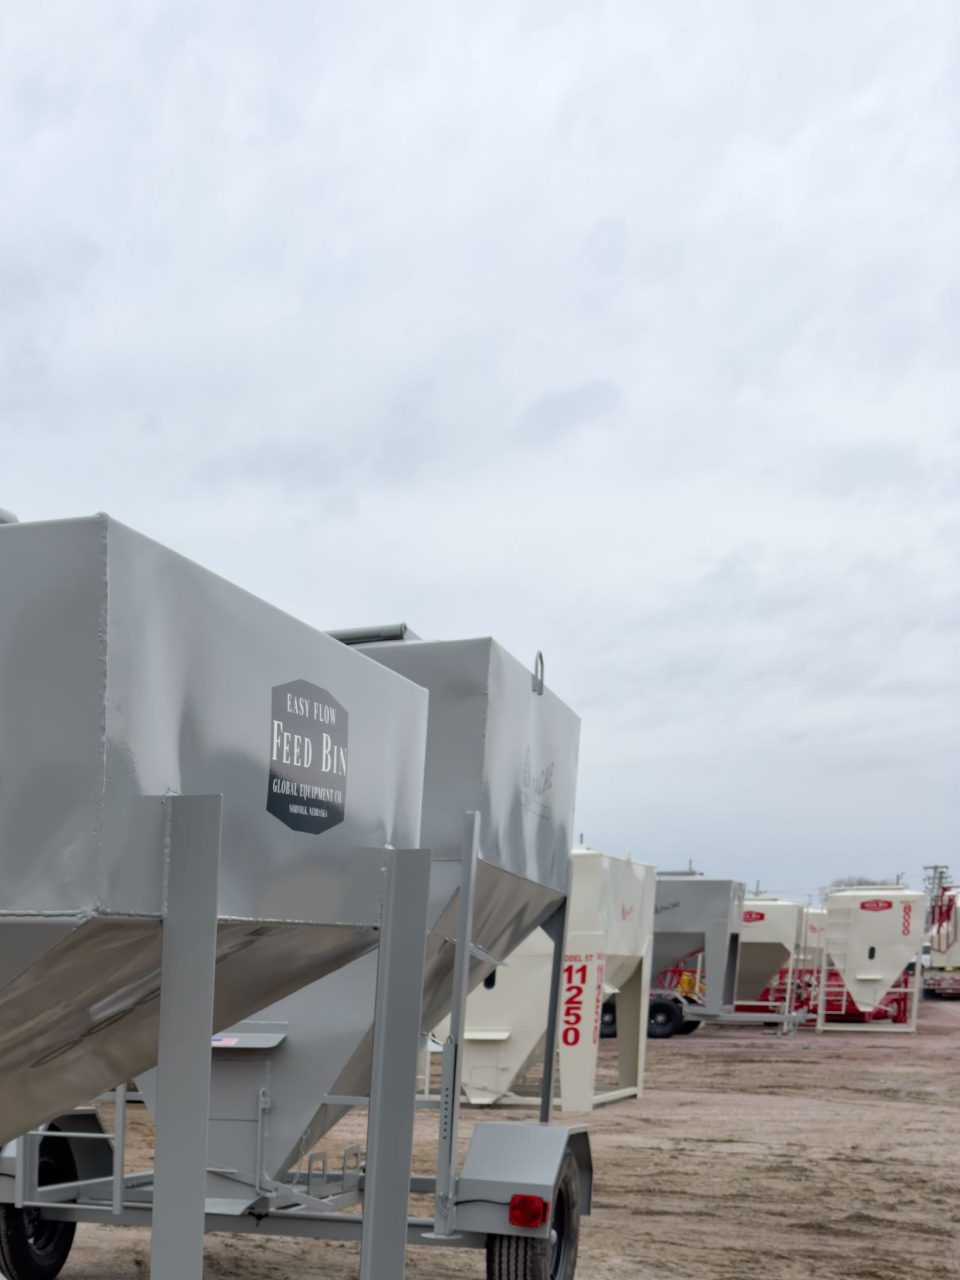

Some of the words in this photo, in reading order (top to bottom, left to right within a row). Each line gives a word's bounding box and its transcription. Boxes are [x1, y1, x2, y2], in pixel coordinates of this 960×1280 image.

[287, 693, 310, 718] EASY
[313, 702, 337, 725] FLOW
[271, 720, 312, 768] FEED
[321, 732, 347, 776] BIN
[272, 778, 298, 796] GLOBAL
[299, 783, 333, 802] EQUIPMENT
